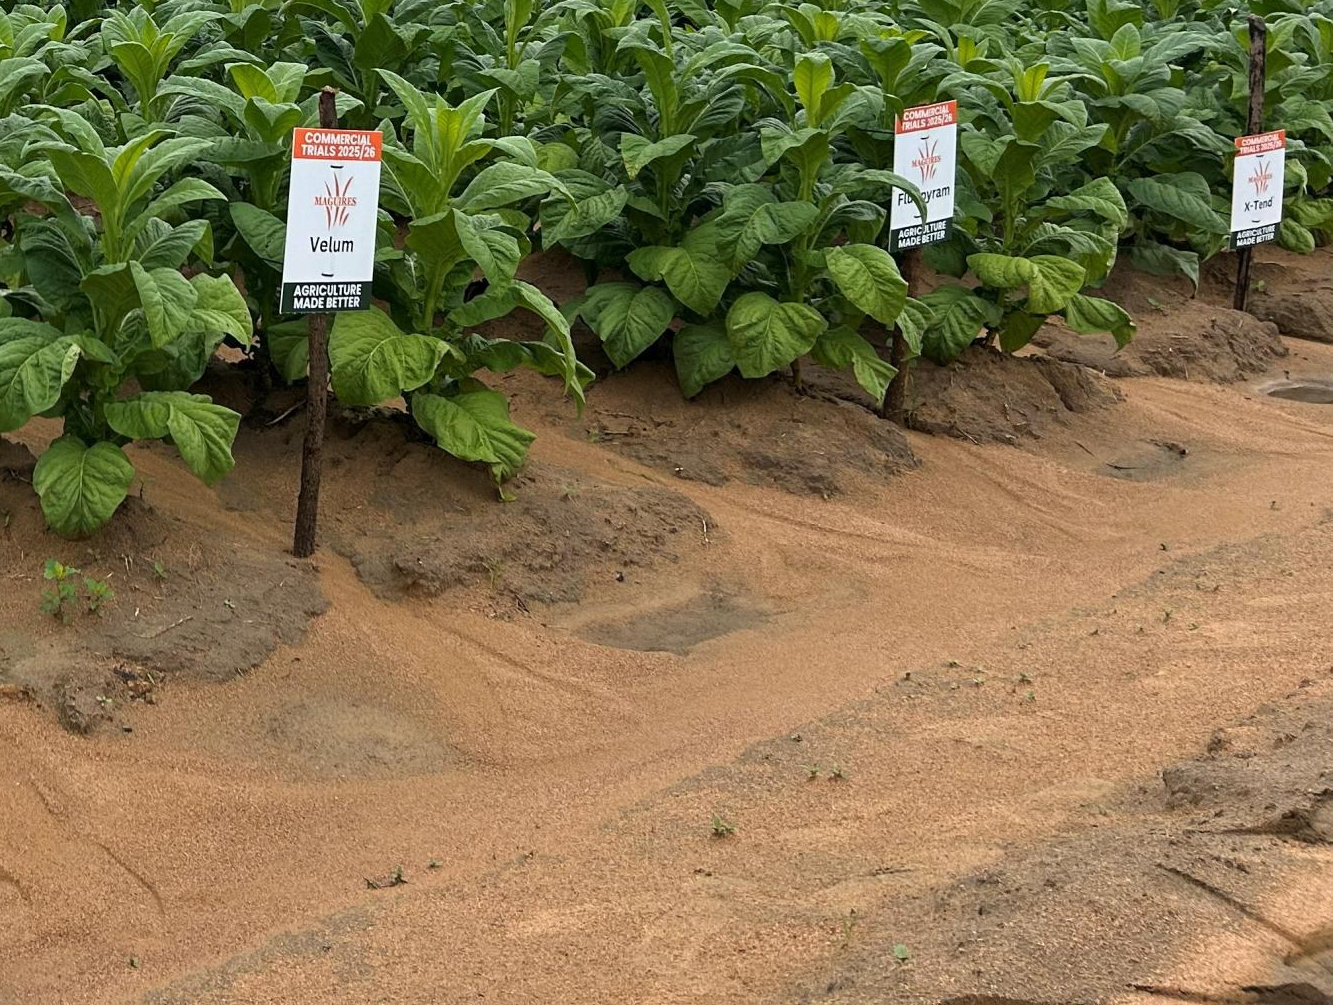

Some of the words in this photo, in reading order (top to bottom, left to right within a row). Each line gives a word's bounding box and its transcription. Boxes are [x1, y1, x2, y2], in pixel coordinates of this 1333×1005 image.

[903, 105, 949, 121] COMMERCIAL
[902, 118, 926, 132] TRIALS
[305, 132, 372, 146] COMMERCIAL
[301, 144, 336, 157] TRIALS
[337, 144, 376, 160] 2025/26
[1240, 144, 1260, 155] TRIALS
[314, 196, 357, 207] MAGUIRES
[898, 186, 950, 207] Flupyram
[1244, 197, 1273, 212] X-Tend
[1237, 225, 1276, 239] AGRICULTURE
[310, 237, 354, 253] Velum
[898, 235, 921, 249] MADE
[921, 230, 945, 244] BETTER
[1237, 236, 1256, 247] MADE
[293, 284, 362, 297] AGRICULTURE
[293, 297, 323, 309] MADE
[326, 296, 360, 308] BETTER
